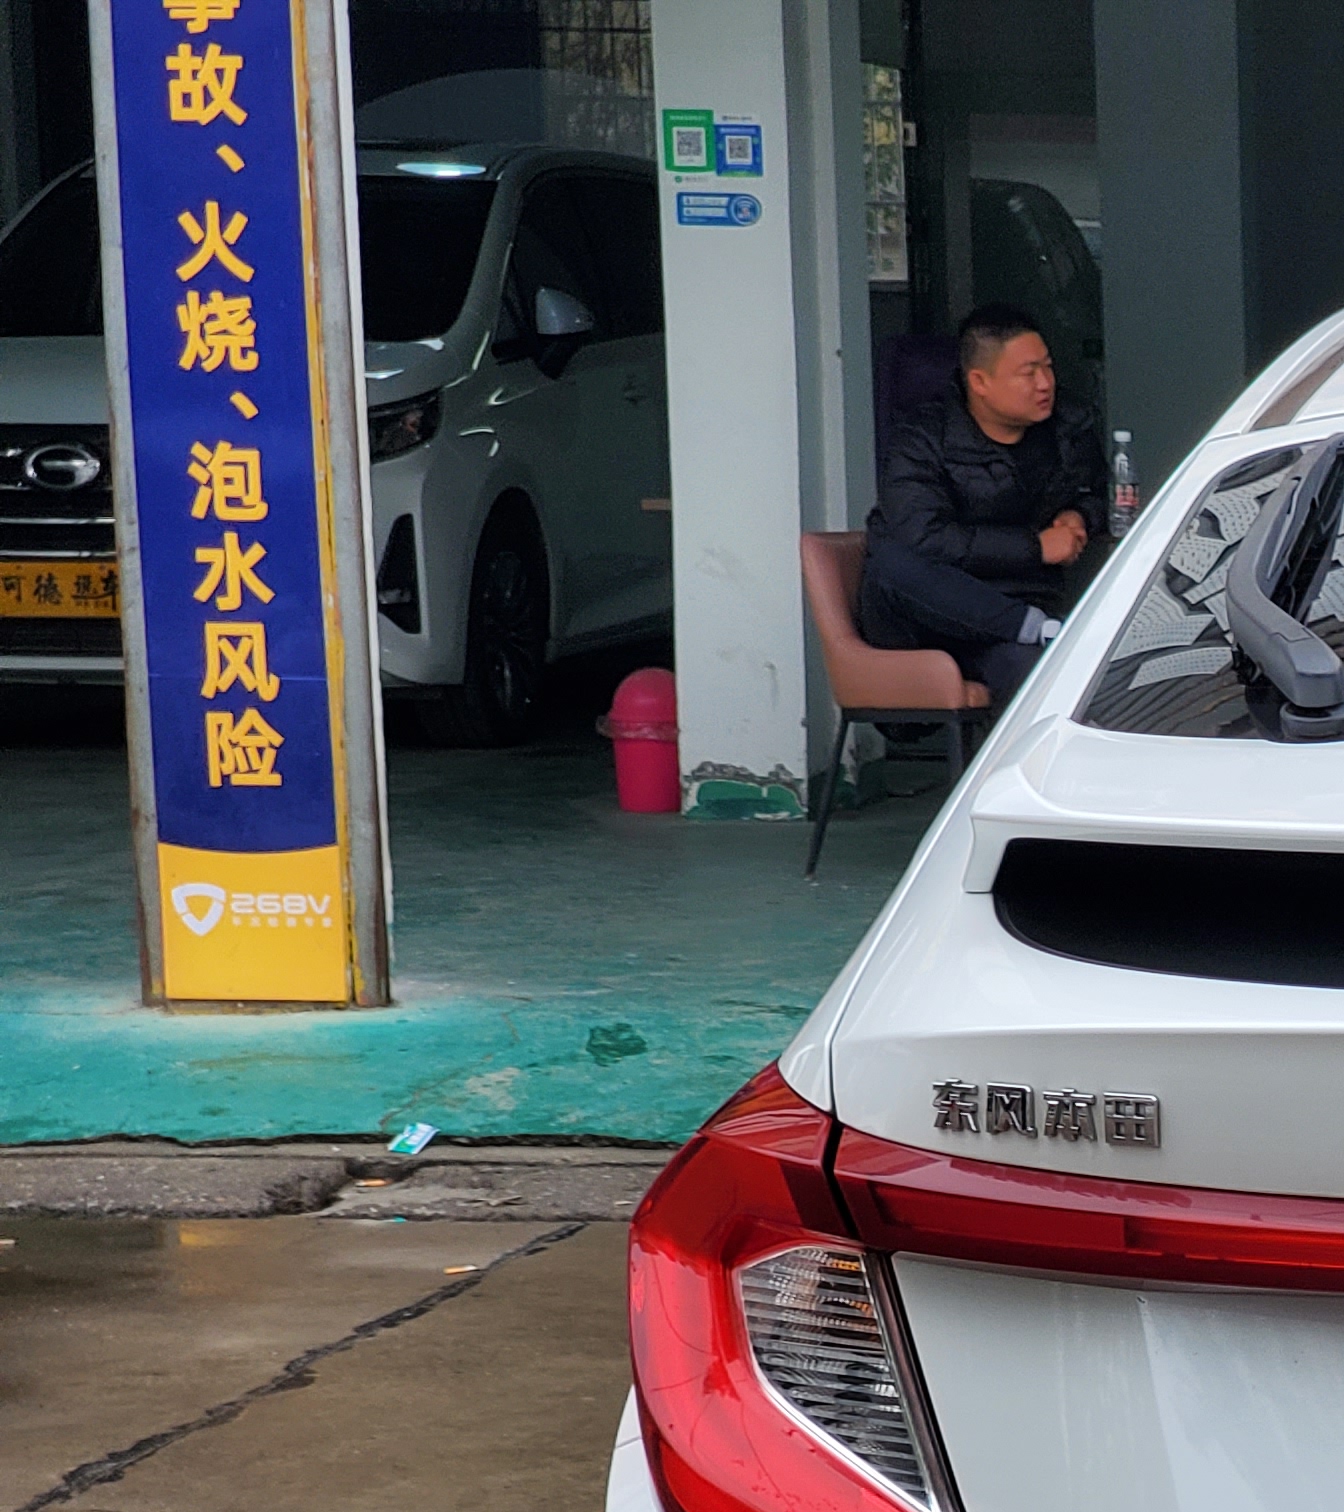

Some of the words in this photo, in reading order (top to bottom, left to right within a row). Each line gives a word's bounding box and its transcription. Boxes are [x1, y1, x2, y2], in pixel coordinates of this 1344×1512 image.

[230, 893, 330, 915] 268V
[931, 1078, 1161, 1148] 东风本田
